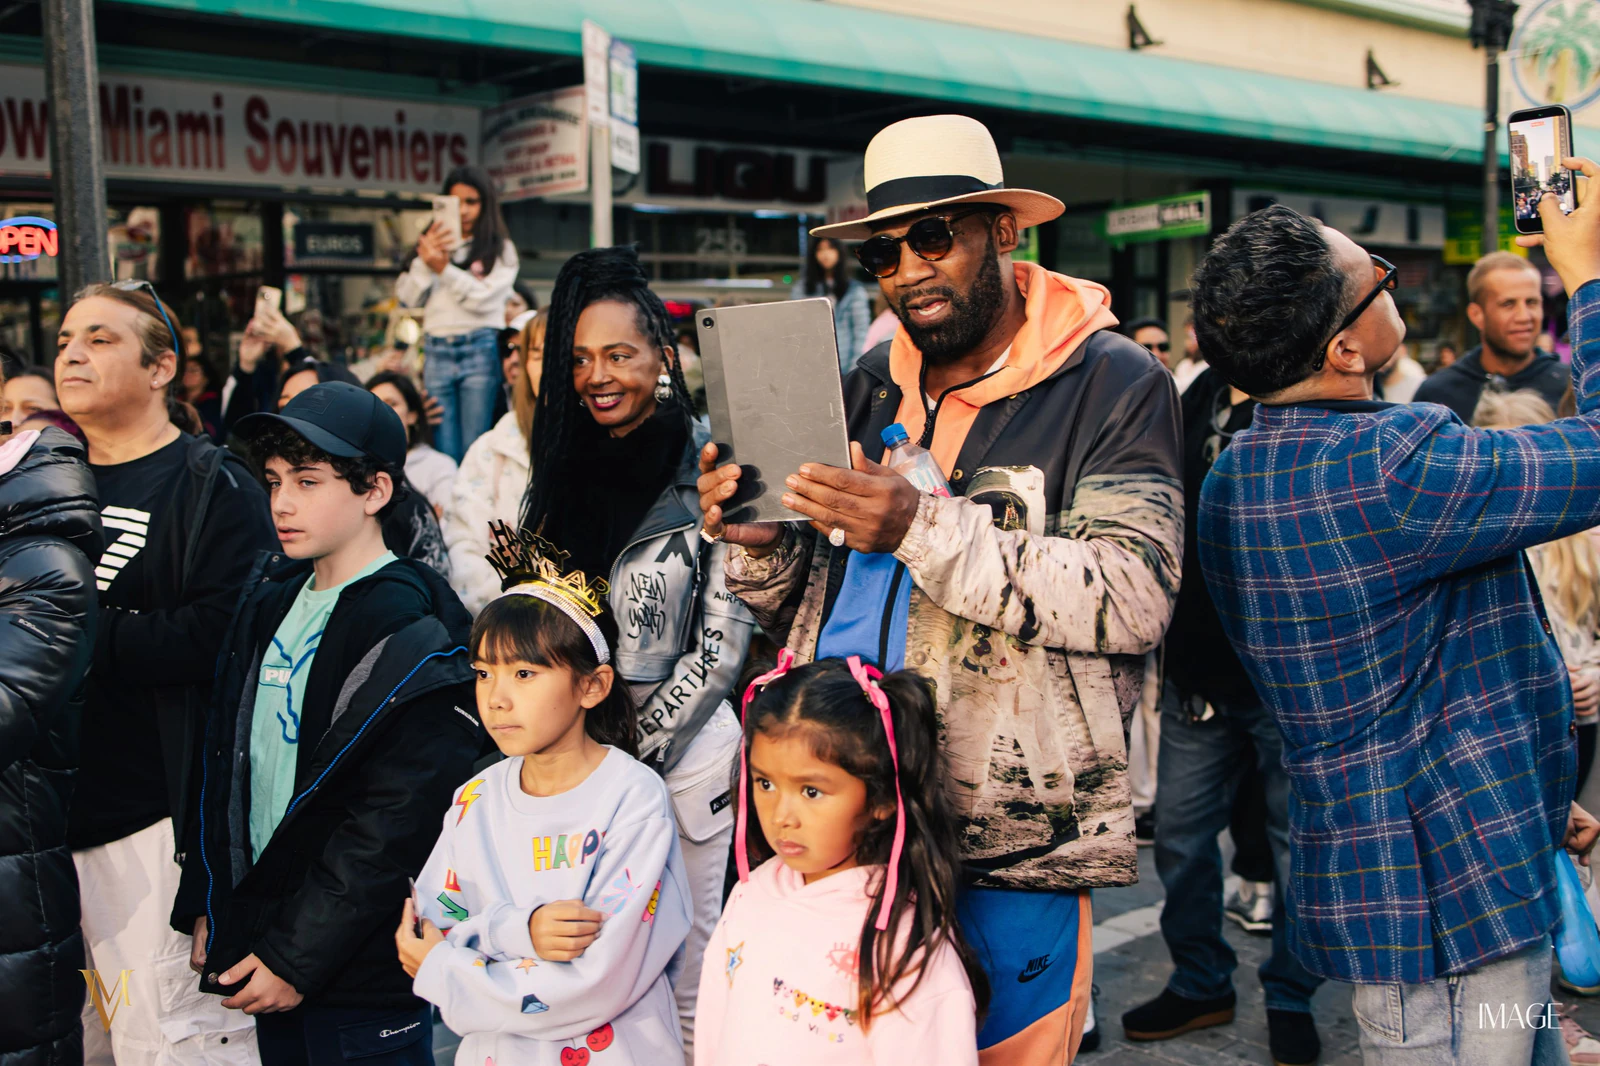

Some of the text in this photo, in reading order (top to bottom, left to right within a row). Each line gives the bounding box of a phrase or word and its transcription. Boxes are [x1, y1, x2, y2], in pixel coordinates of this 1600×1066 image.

[100, 82, 226, 171] Miami
[244, 95, 468, 185] Souveniers
[0, 225, 58, 257] PEN
[626, 571, 667, 605] NEW
[532, 829, 607, 872] HAPP
[1025, 954, 1050, 973] NIKE
[379, 1021, 421, 1038] Champion
